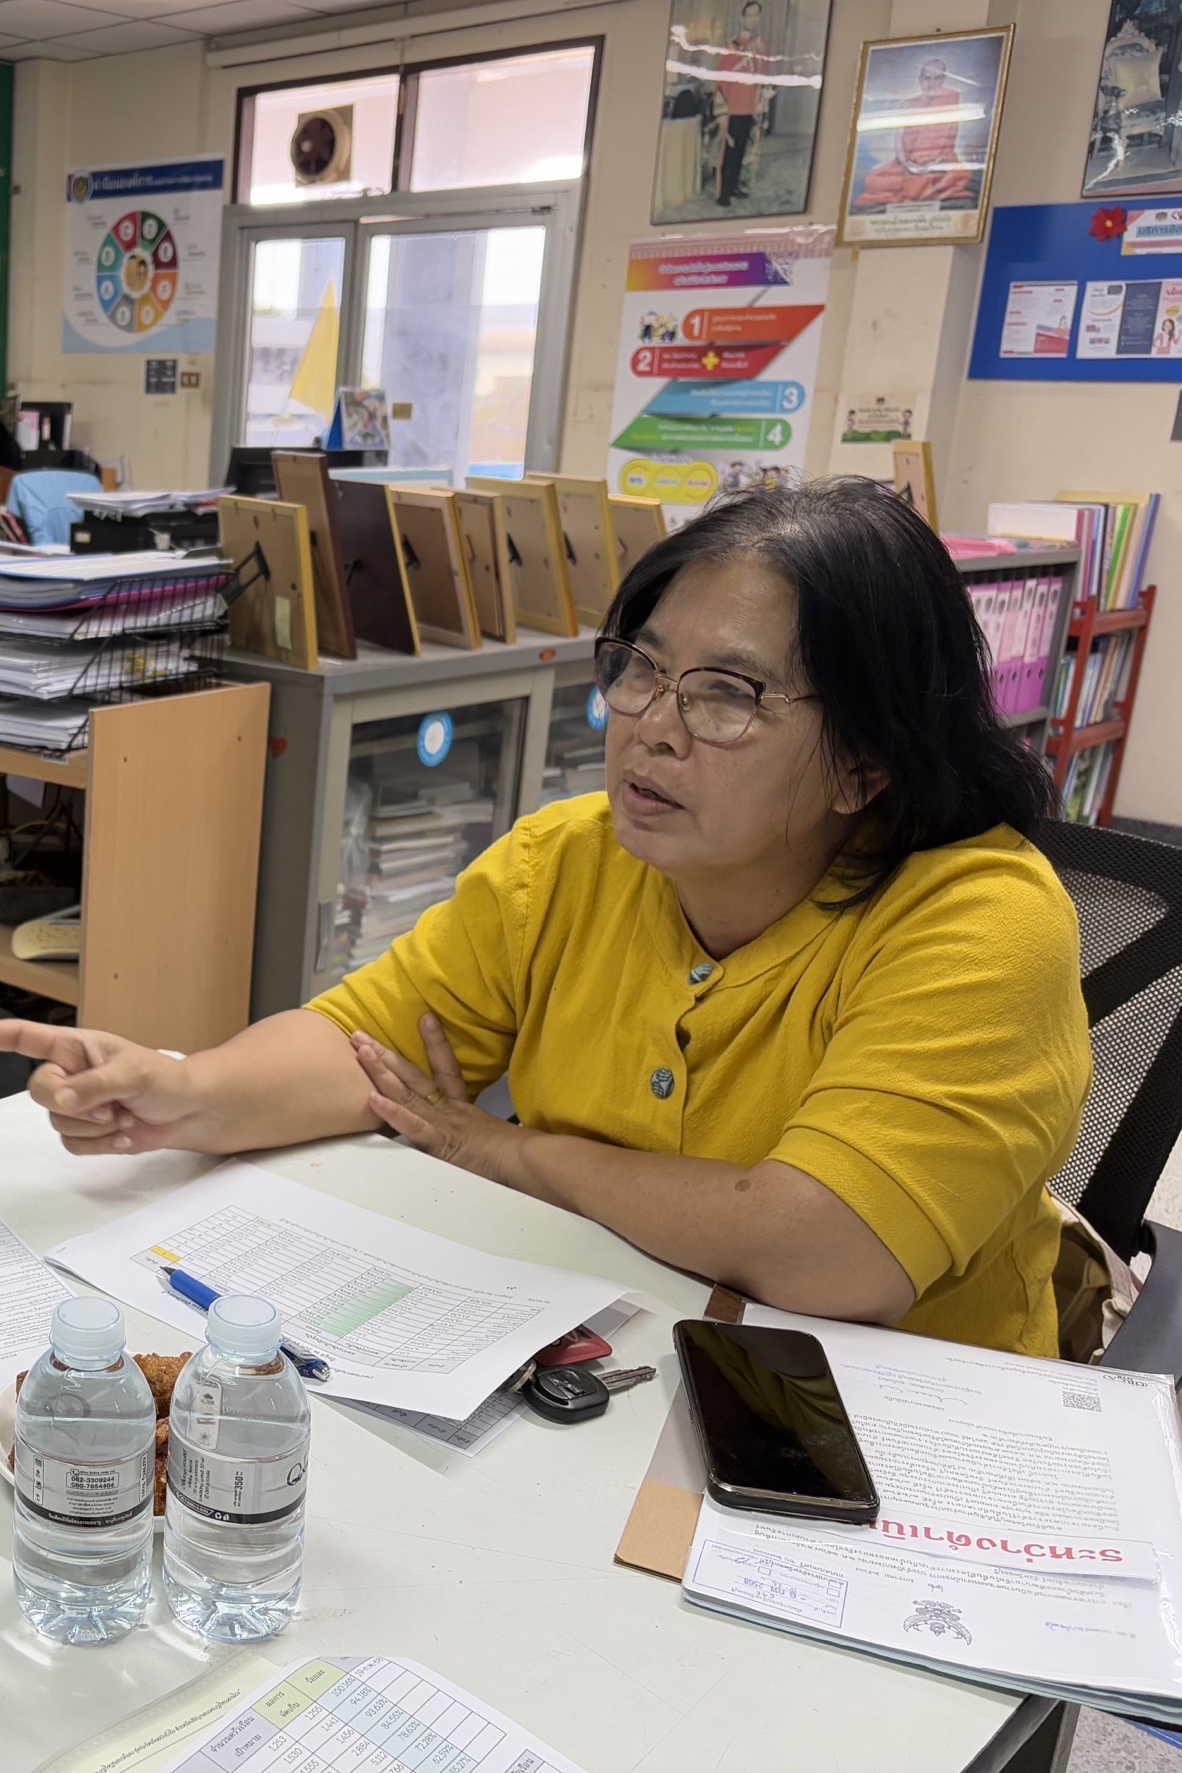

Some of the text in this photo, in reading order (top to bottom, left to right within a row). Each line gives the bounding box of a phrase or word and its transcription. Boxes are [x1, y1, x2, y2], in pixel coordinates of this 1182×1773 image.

[690, 315, 701, 336] 1
[637, 352, 651, 372] 2
[783, 388, 798, 408] 3
[767, 424, 783, 445] 4
[346, 1683, 375, 1708] 94.18%
[206, 1665, 327, 1754] จำนวนครัวเรือน ผลการ ร้อยละ
[266, 1733, 290, 1754] 1,253
[303, 1702, 325, 1722] 1,255
[328, 1672, 360, 1699] 100.16%
[334, 1725, 357, 1746] 1,456
[362, 1695, 391, 1720] 93.63%
[378, 1706, 407, 1732] 84.55%
[230, 1697, 302, 1758] เป้าหมาย จัดเก็บ
[394, 1718, 424, 1743] 78.63%
[411, 1729, 440, 1754] 72.28%
[428, 1740, 457, 1766] 62.59%
